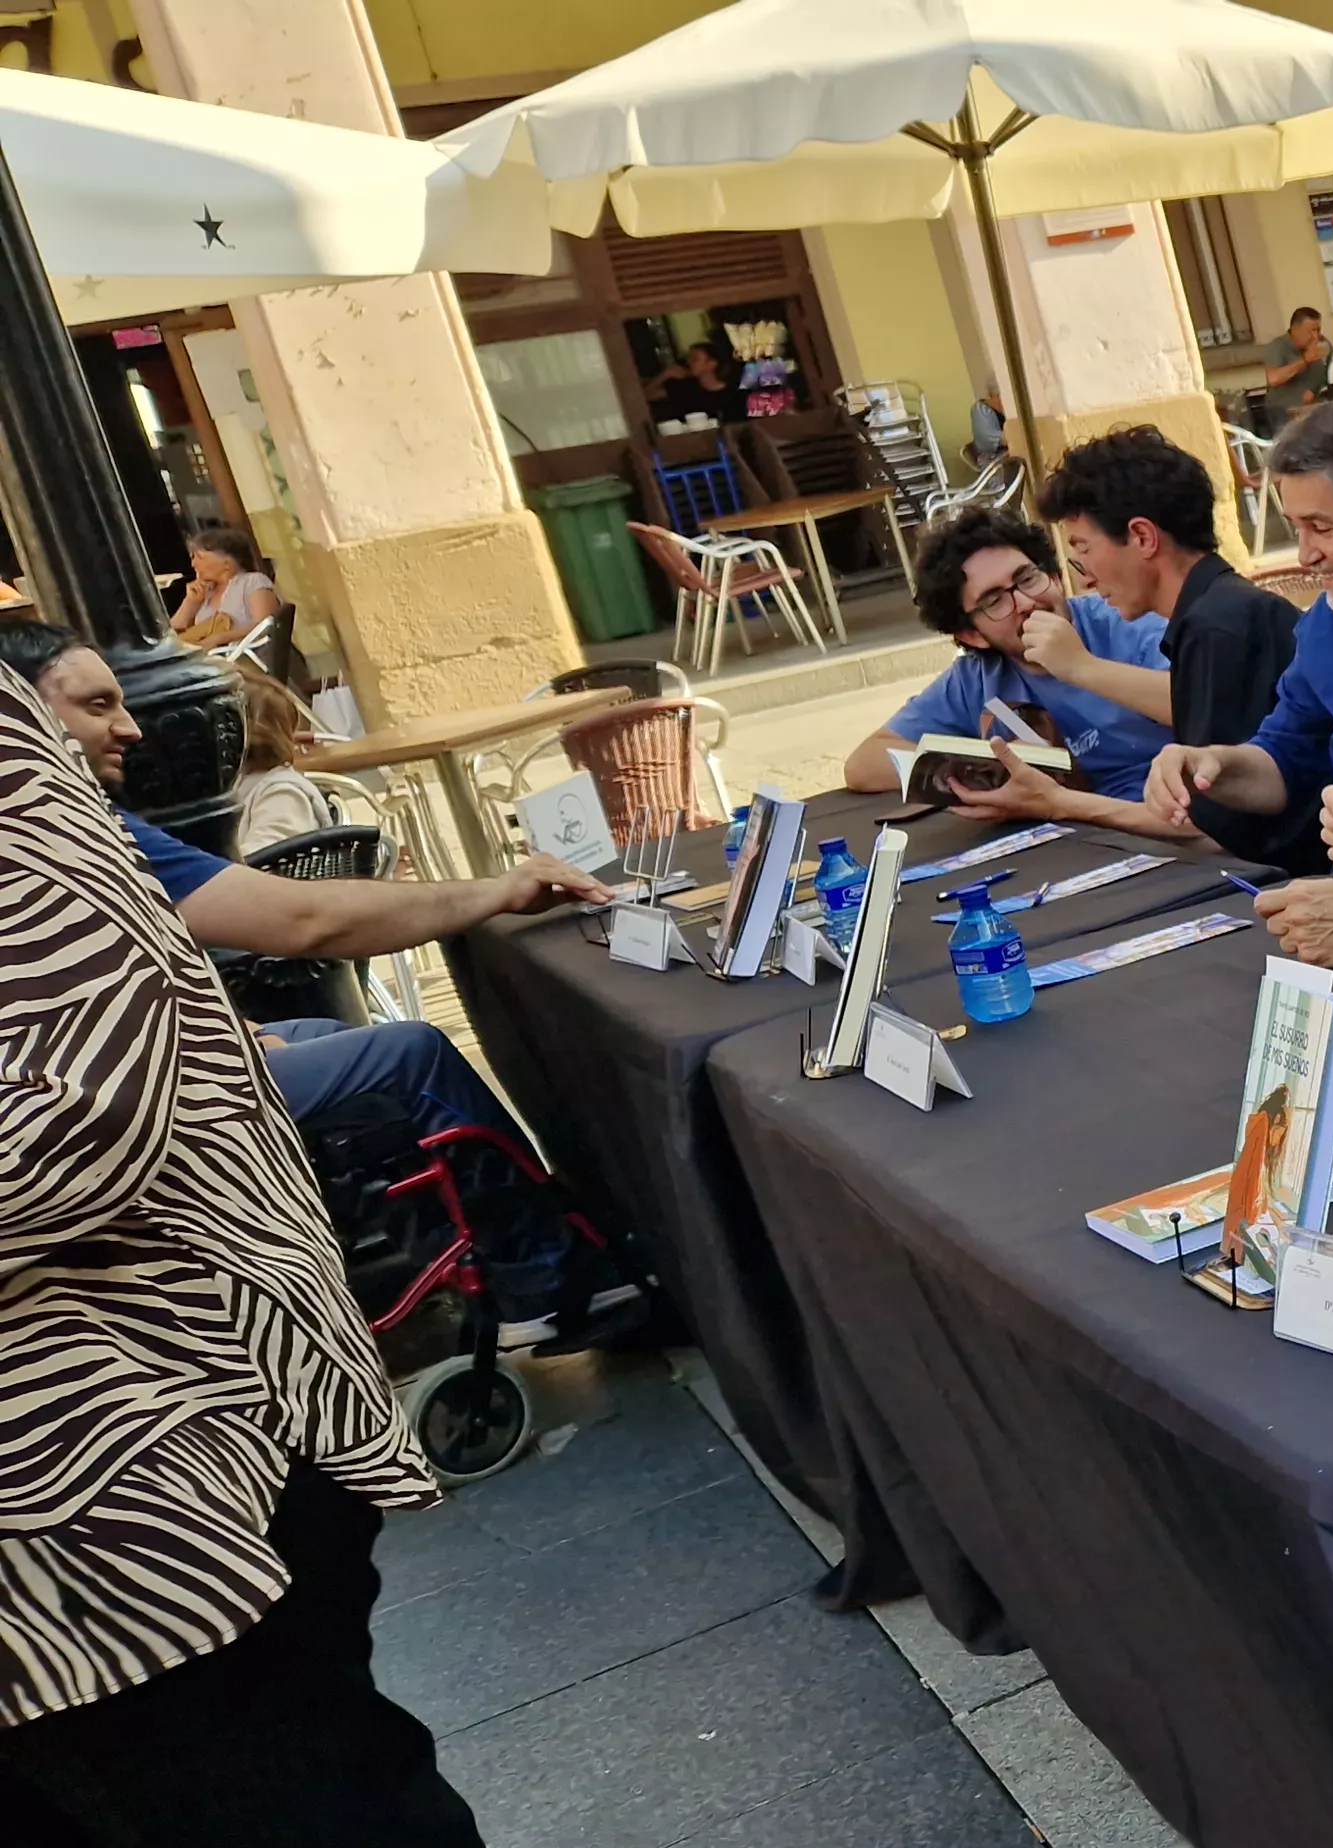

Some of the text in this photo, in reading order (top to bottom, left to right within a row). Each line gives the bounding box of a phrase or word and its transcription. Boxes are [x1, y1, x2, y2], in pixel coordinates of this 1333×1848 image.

[1271, 1021, 1309, 1051] EL SUSURRO
[1262, 1043, 1310, 1077] DE MIS SUEÑOS
